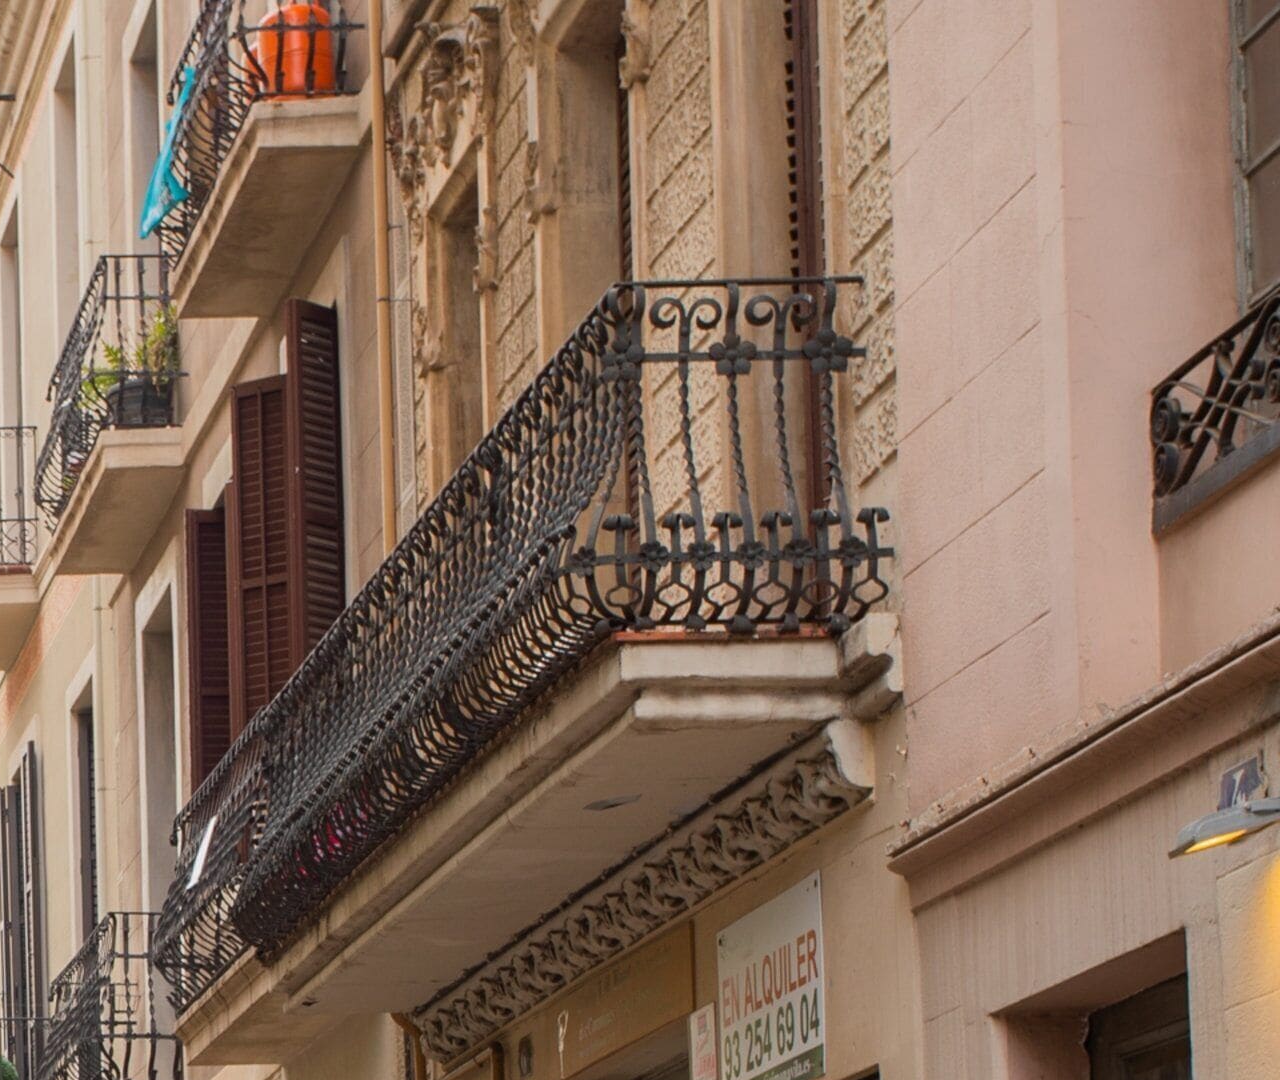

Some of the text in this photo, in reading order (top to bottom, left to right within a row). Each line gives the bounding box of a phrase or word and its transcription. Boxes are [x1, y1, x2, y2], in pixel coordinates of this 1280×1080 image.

[721, 973, 740, 1028] EN
[743, 928, 819, 1019] ALQUILER
[745, 1012, 772, 1074] 254
[776, 1000, 795, 1057] 69
[800, 988, 820, 1045] 04
